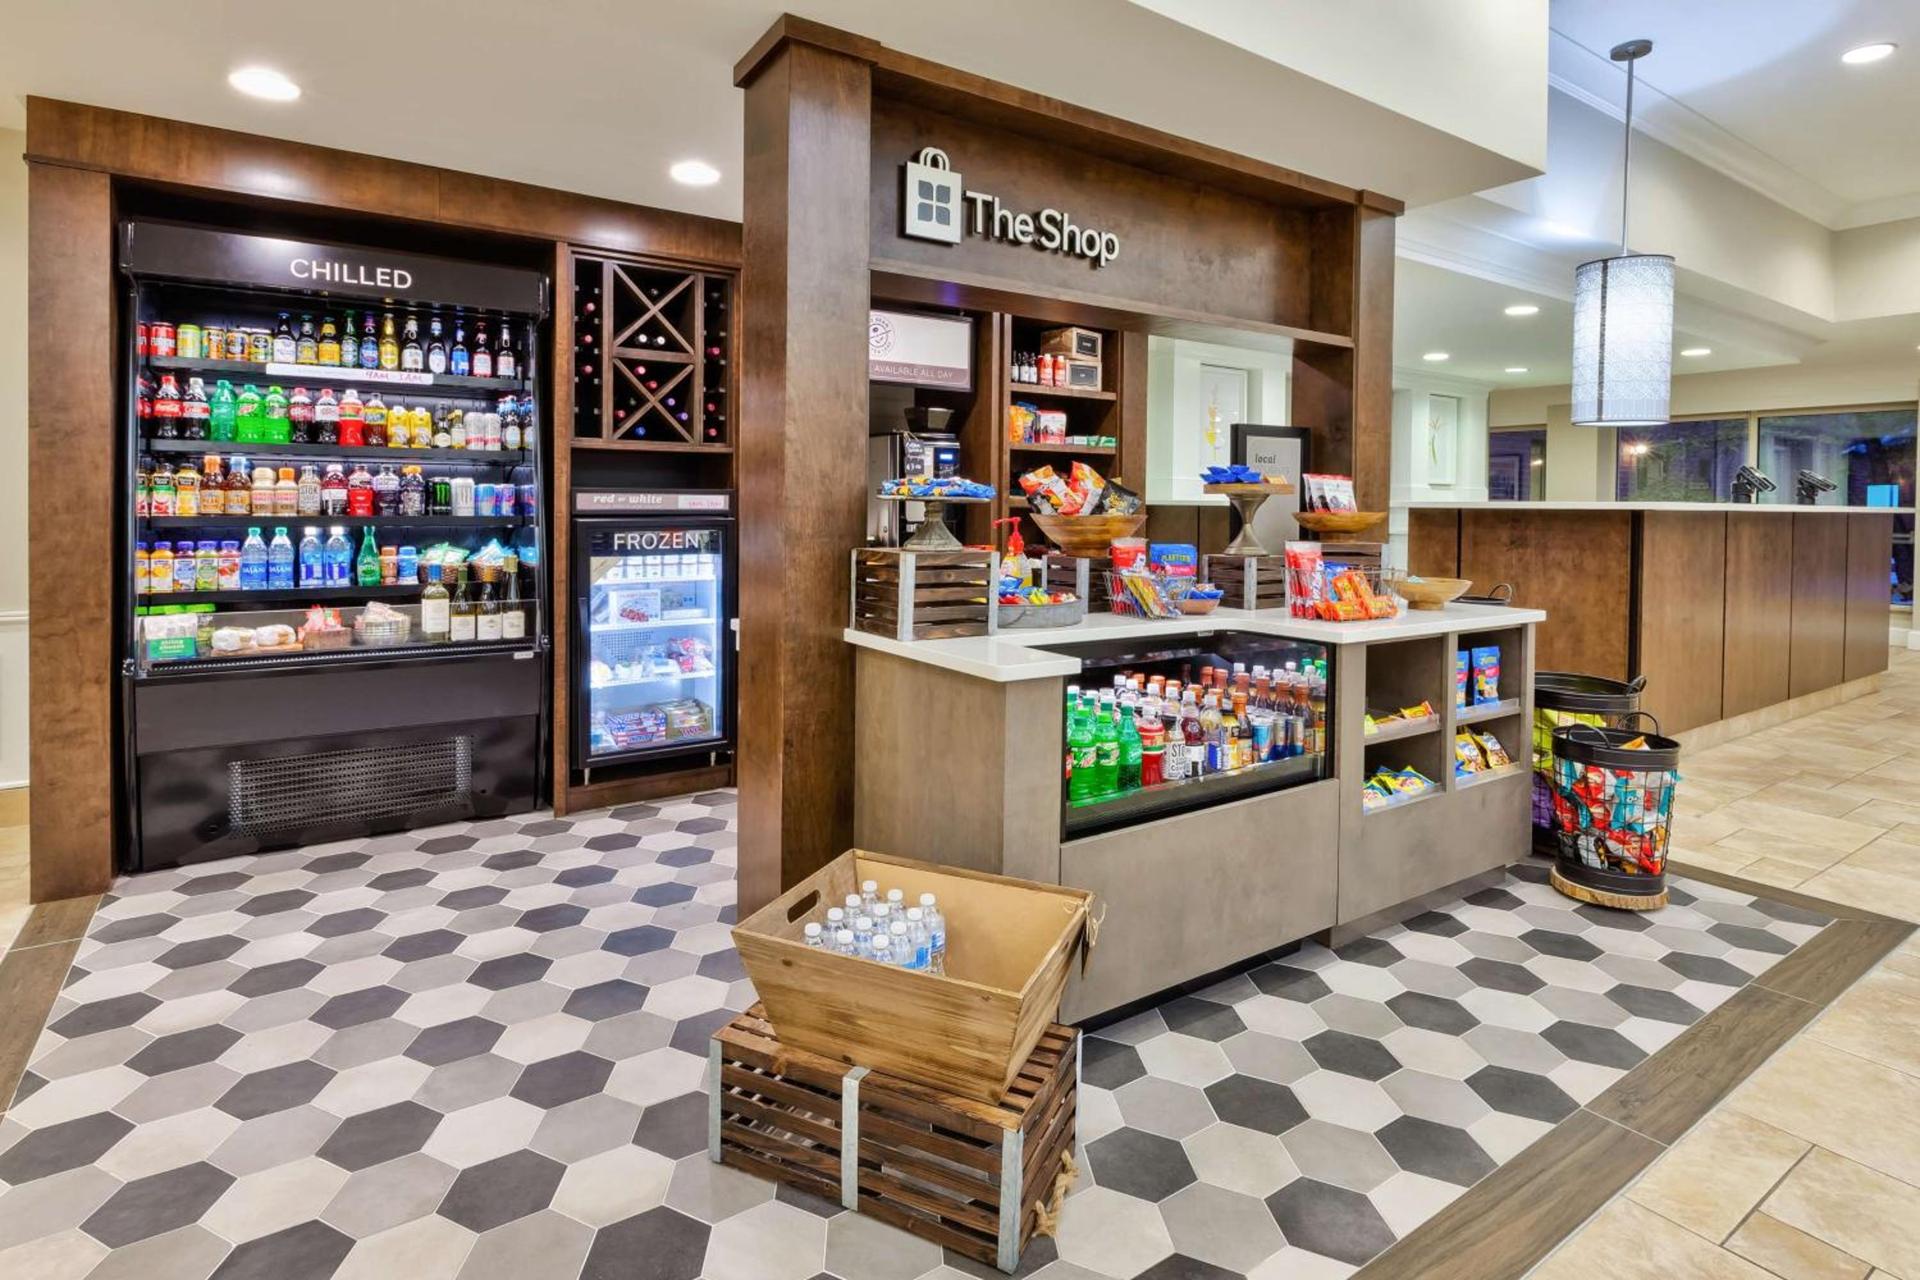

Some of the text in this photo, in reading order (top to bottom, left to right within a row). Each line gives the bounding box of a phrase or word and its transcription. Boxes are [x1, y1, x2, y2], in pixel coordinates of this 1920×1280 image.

[290, 258, 412, 290] CHILLED
[873, 364, 953, 379] AVAILABLE ALL DAY
[1255, 453, 1276, 464] local
[592, 494, 616, 503] red
[629, 495, 663, 504] white
[613, 532, 700, 551] FROZEN
